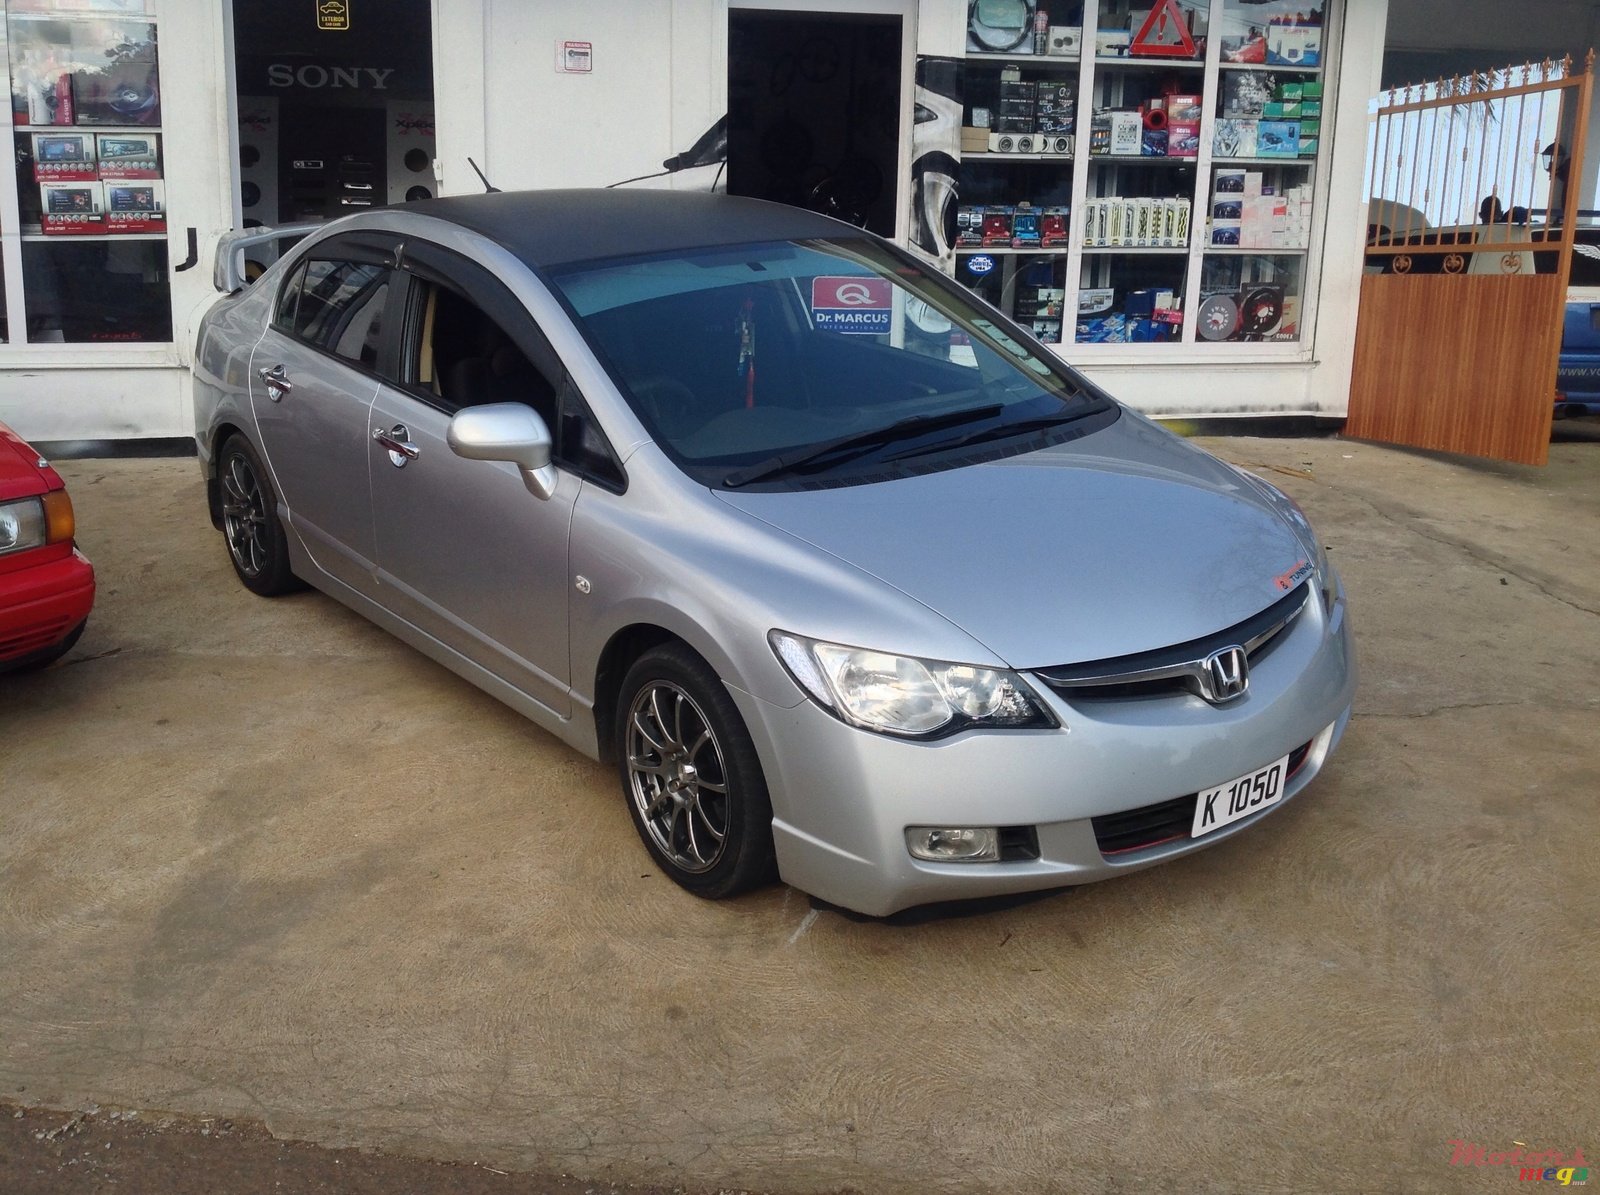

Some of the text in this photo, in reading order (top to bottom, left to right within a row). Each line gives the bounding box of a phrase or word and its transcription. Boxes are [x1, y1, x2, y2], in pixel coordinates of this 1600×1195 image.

[268, 64, 395, 89] SONY
[816, 313, 888, 323] Dr. MARCUS
[1201, 765, 1281, 828] K 1050
